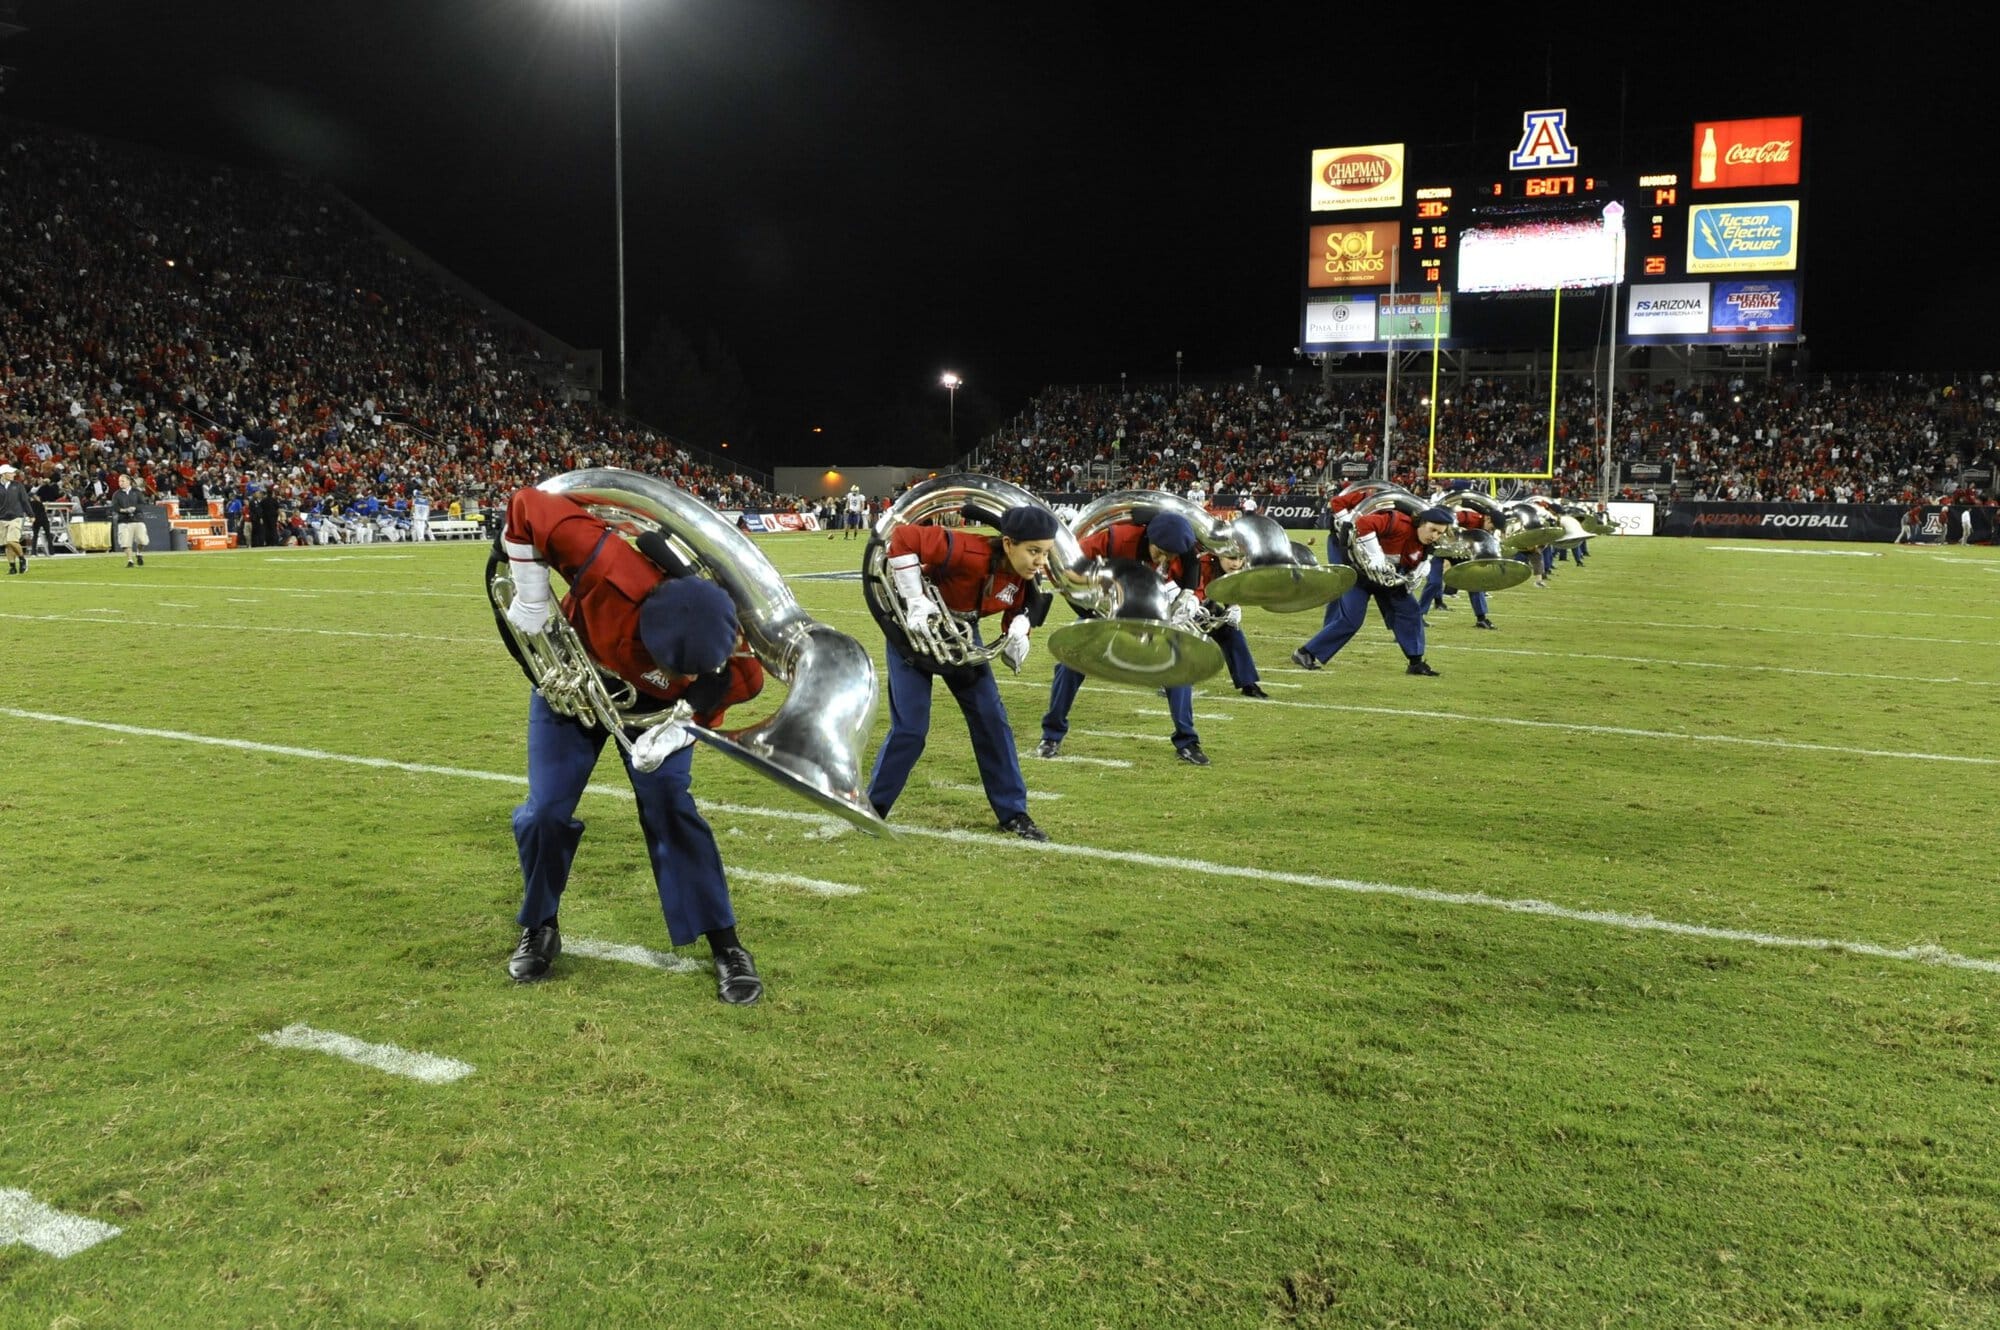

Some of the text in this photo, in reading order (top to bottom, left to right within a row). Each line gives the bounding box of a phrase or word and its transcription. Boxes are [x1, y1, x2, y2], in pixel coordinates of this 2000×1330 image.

[1725, 141, 1794, 165] Coca-Cola
[1328, 161, 1385, 179] CHAPMAN
[1330, 176, 1385, 185] AUTOMOTIVE
[1525, 177, 1575, 196] 6:07
[1585, 178, 1594, 191] 3
[1493, 183, 1502, 196] 3
[1656, 189, 1675, 204] 14
[1417, 202, 1442, 217] 30
[1718, 213, 1769, 226] Tucson
[1652, 225, 1662, 238] 3
[1723, 225, 1783, 239] Electric
[1325, 230, 1384, 260] SOL
[1413, 236, 1421, 249] 3
[1434, 235, 1447, 248] 12
[1728, 239, 1781, 251] Power
[1325, 258, 1384, 273] CASINOS
[1646, 258, 1666, 273] 25
[1427, 268, 1439, 281] 18
[1636, 299, 1702, 310] FS ARIZONA
[1728, 293, 1778, 304] ENERGY
[1739, 300, 1778, 309] DRINK
[1417, 304, 1448, 313] CENTRS
[1693, 513, 1849, 529] ARIZONA FOOTBALL
